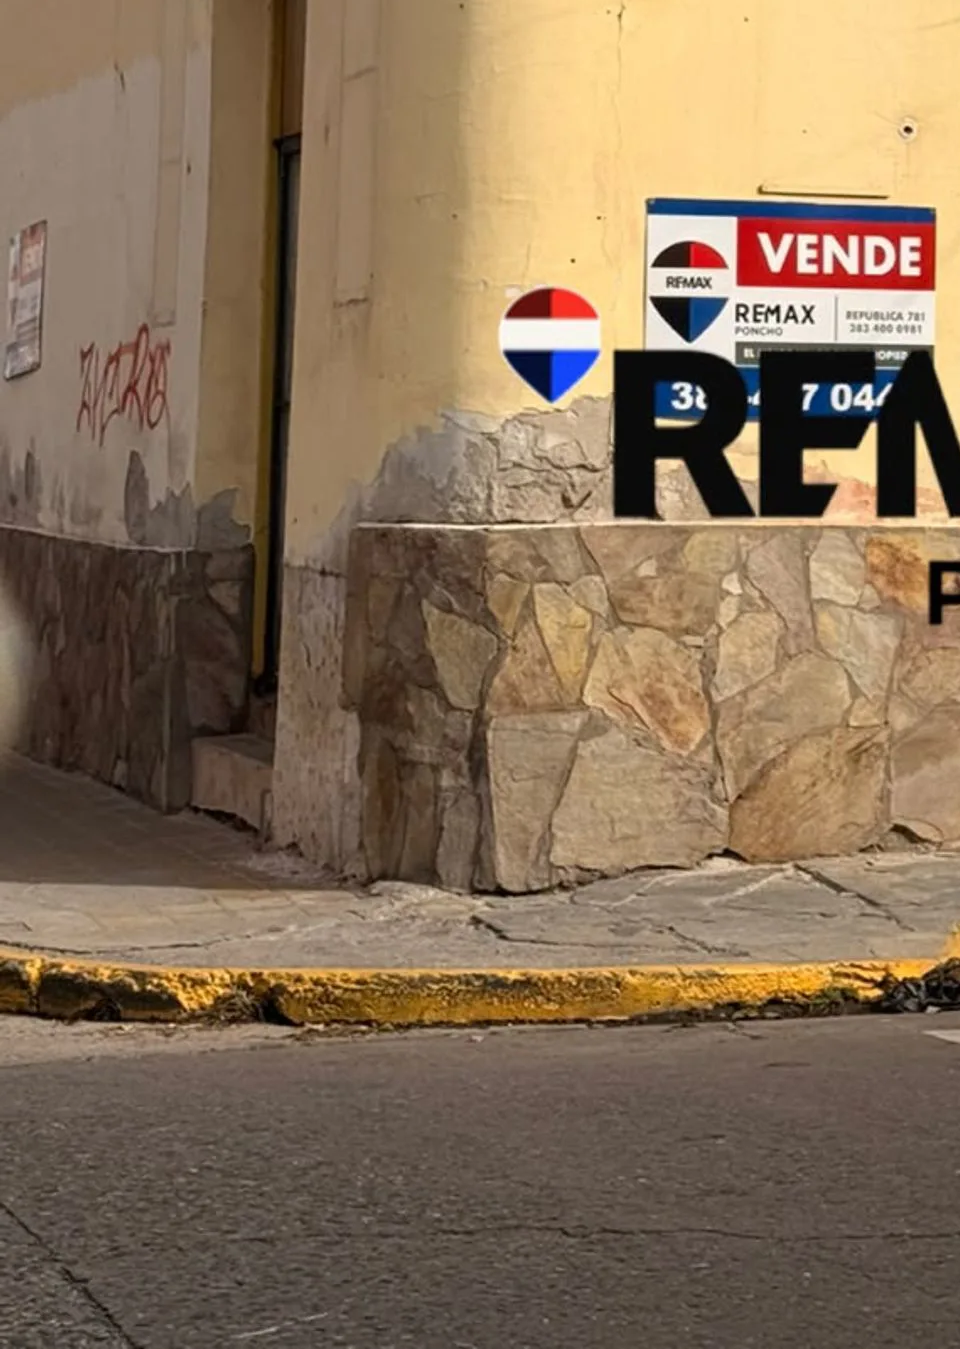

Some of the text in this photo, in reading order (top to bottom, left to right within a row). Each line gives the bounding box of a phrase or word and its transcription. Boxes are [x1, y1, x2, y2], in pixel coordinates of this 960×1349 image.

[757, 232, 922, 277] VENDE
[666, 275, 712, 289] REMAX
[735, 303, 815, 324] REMAX
[908, 311, 925, 322] 781
[735, 326, 783, 337] PONCHO
